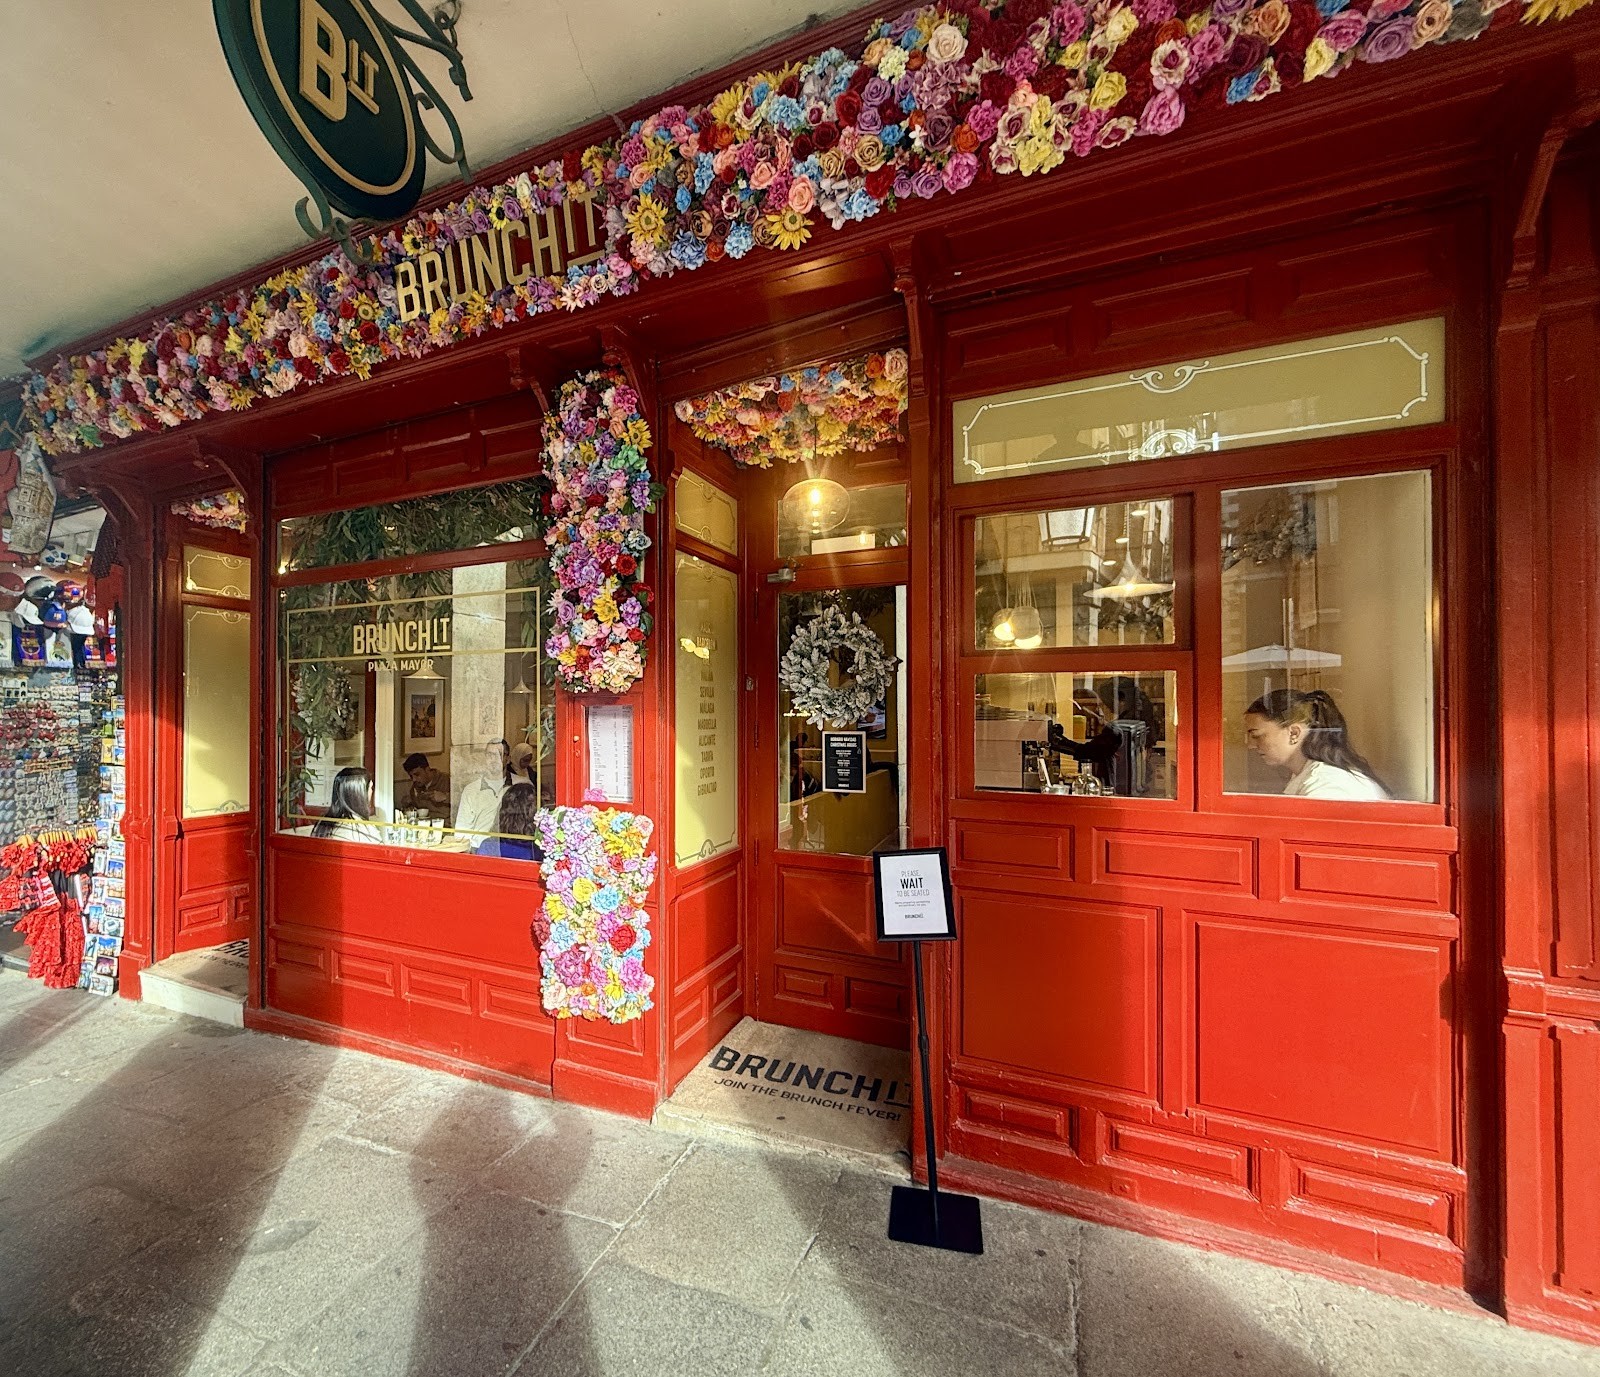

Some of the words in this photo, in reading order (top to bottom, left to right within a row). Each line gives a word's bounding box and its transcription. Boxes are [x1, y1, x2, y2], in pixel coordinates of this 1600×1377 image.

[394, 190, 605, 322] BRUNCHIT
[353, 617, 451, 654] BRUNCHIT
[368, 660, 398, 673] PLAZA
[400, 659, 434, 671] MAYOR
[900, 877, 923, 889] WAIT
[714, 1078, 748, 1090] JOIN
[752, 1084, 779, 1097] THE
[780, 1090, 843, 1111] BRUNCH
[847, 1104, 901, 1122] FEVER!
